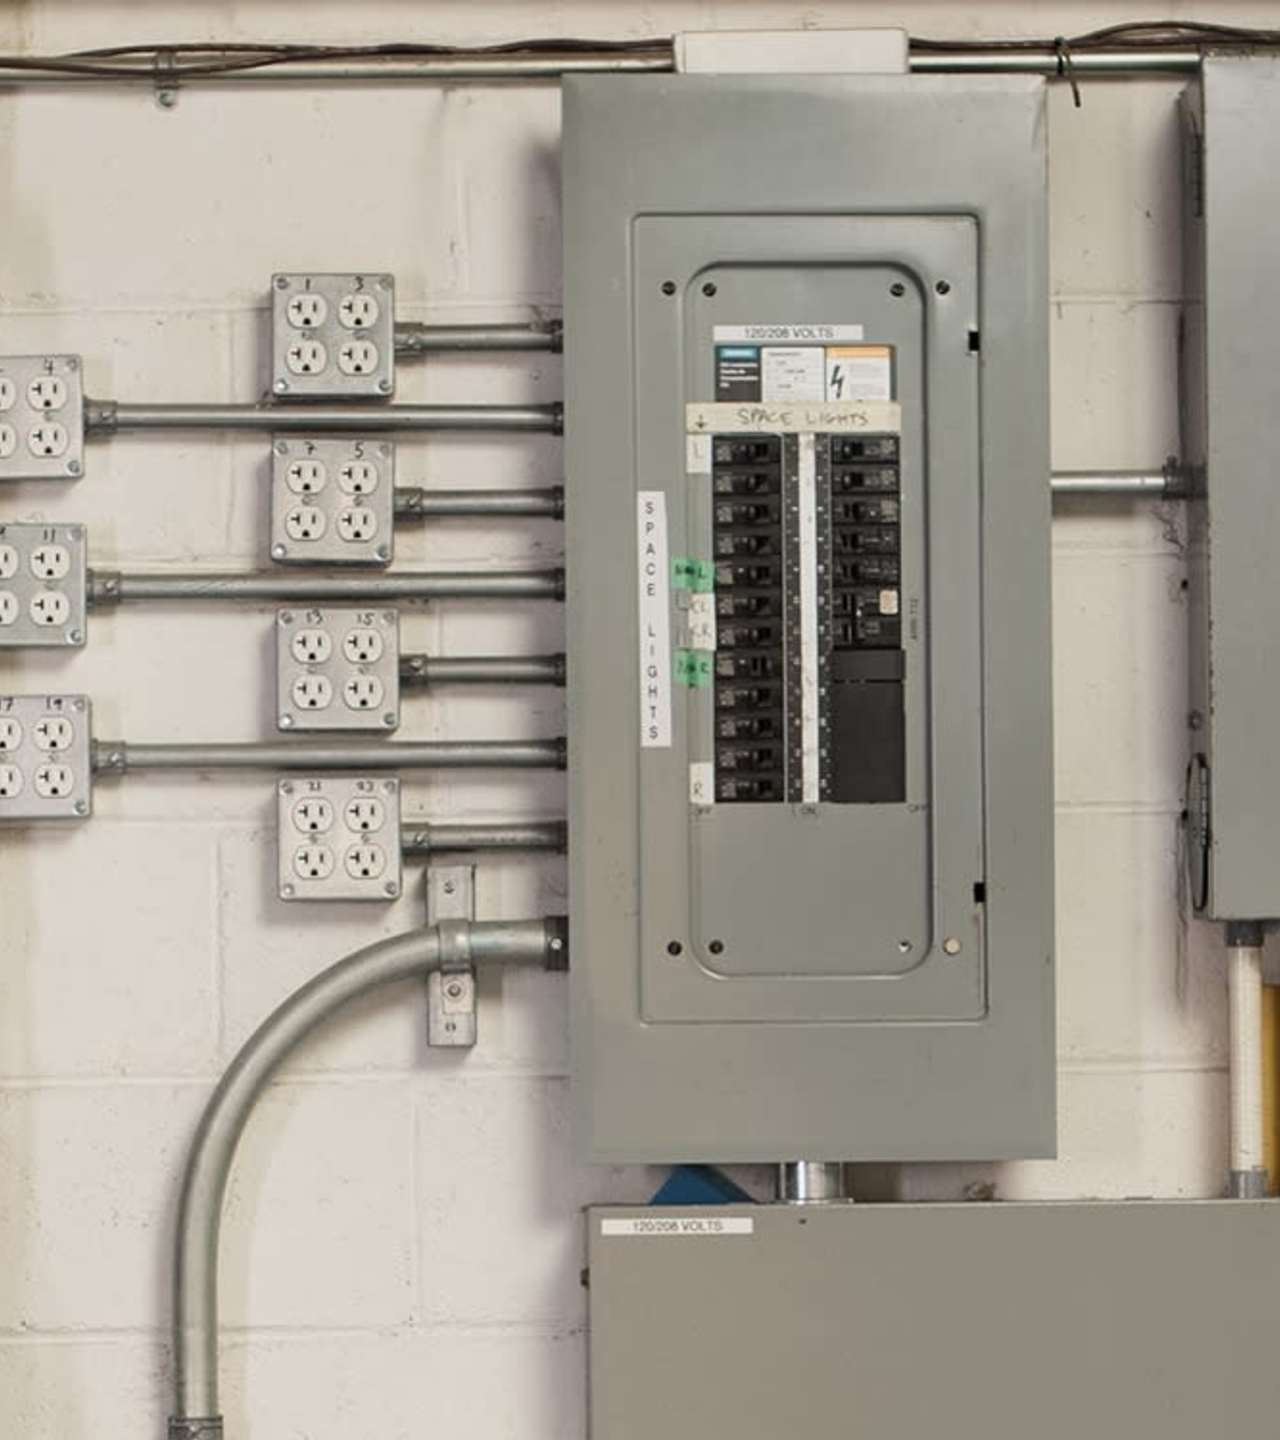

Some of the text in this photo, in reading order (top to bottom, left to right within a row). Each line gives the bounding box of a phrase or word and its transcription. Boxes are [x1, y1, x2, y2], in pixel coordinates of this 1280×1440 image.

[793, 327, 834, 339] VOLTS
[736, 409, 869, 427] SPACE LIGHTS
[644, 502, 659, 740] SPACE LIGHTS
[681, 1220, 723, 1232] VOLTS
